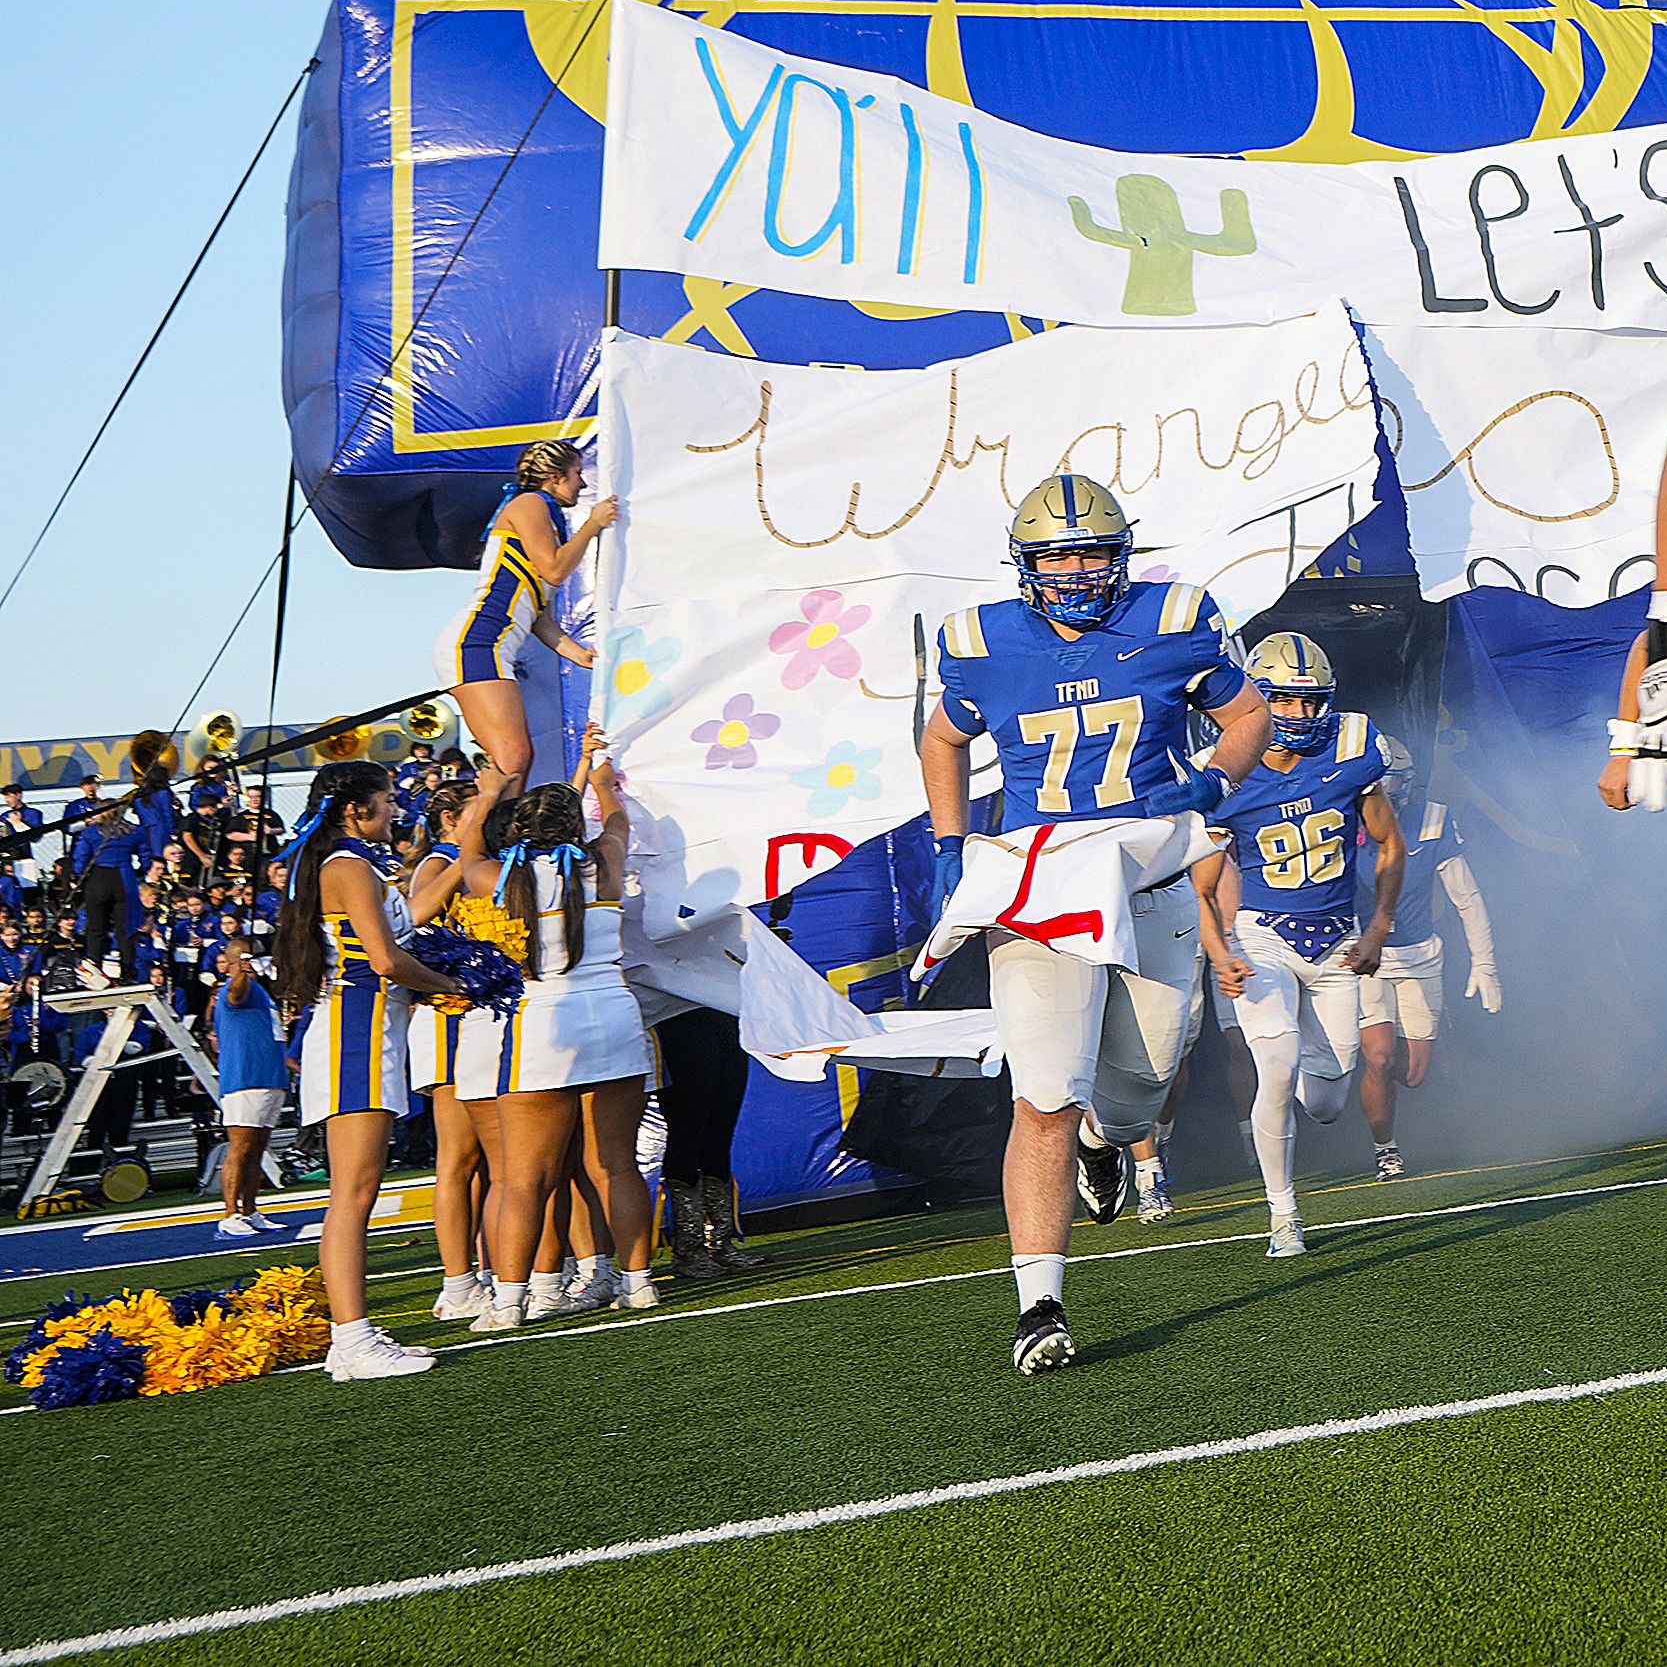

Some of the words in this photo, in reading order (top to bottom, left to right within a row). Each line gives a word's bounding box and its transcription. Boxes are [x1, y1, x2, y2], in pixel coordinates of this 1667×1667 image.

[1055, 678, 1100, 703] TFND
[1016, 694, 1145, 814] 77
[1277, 797, 1313, 820] TFND
[1254, 807, 1346, 889] 96
